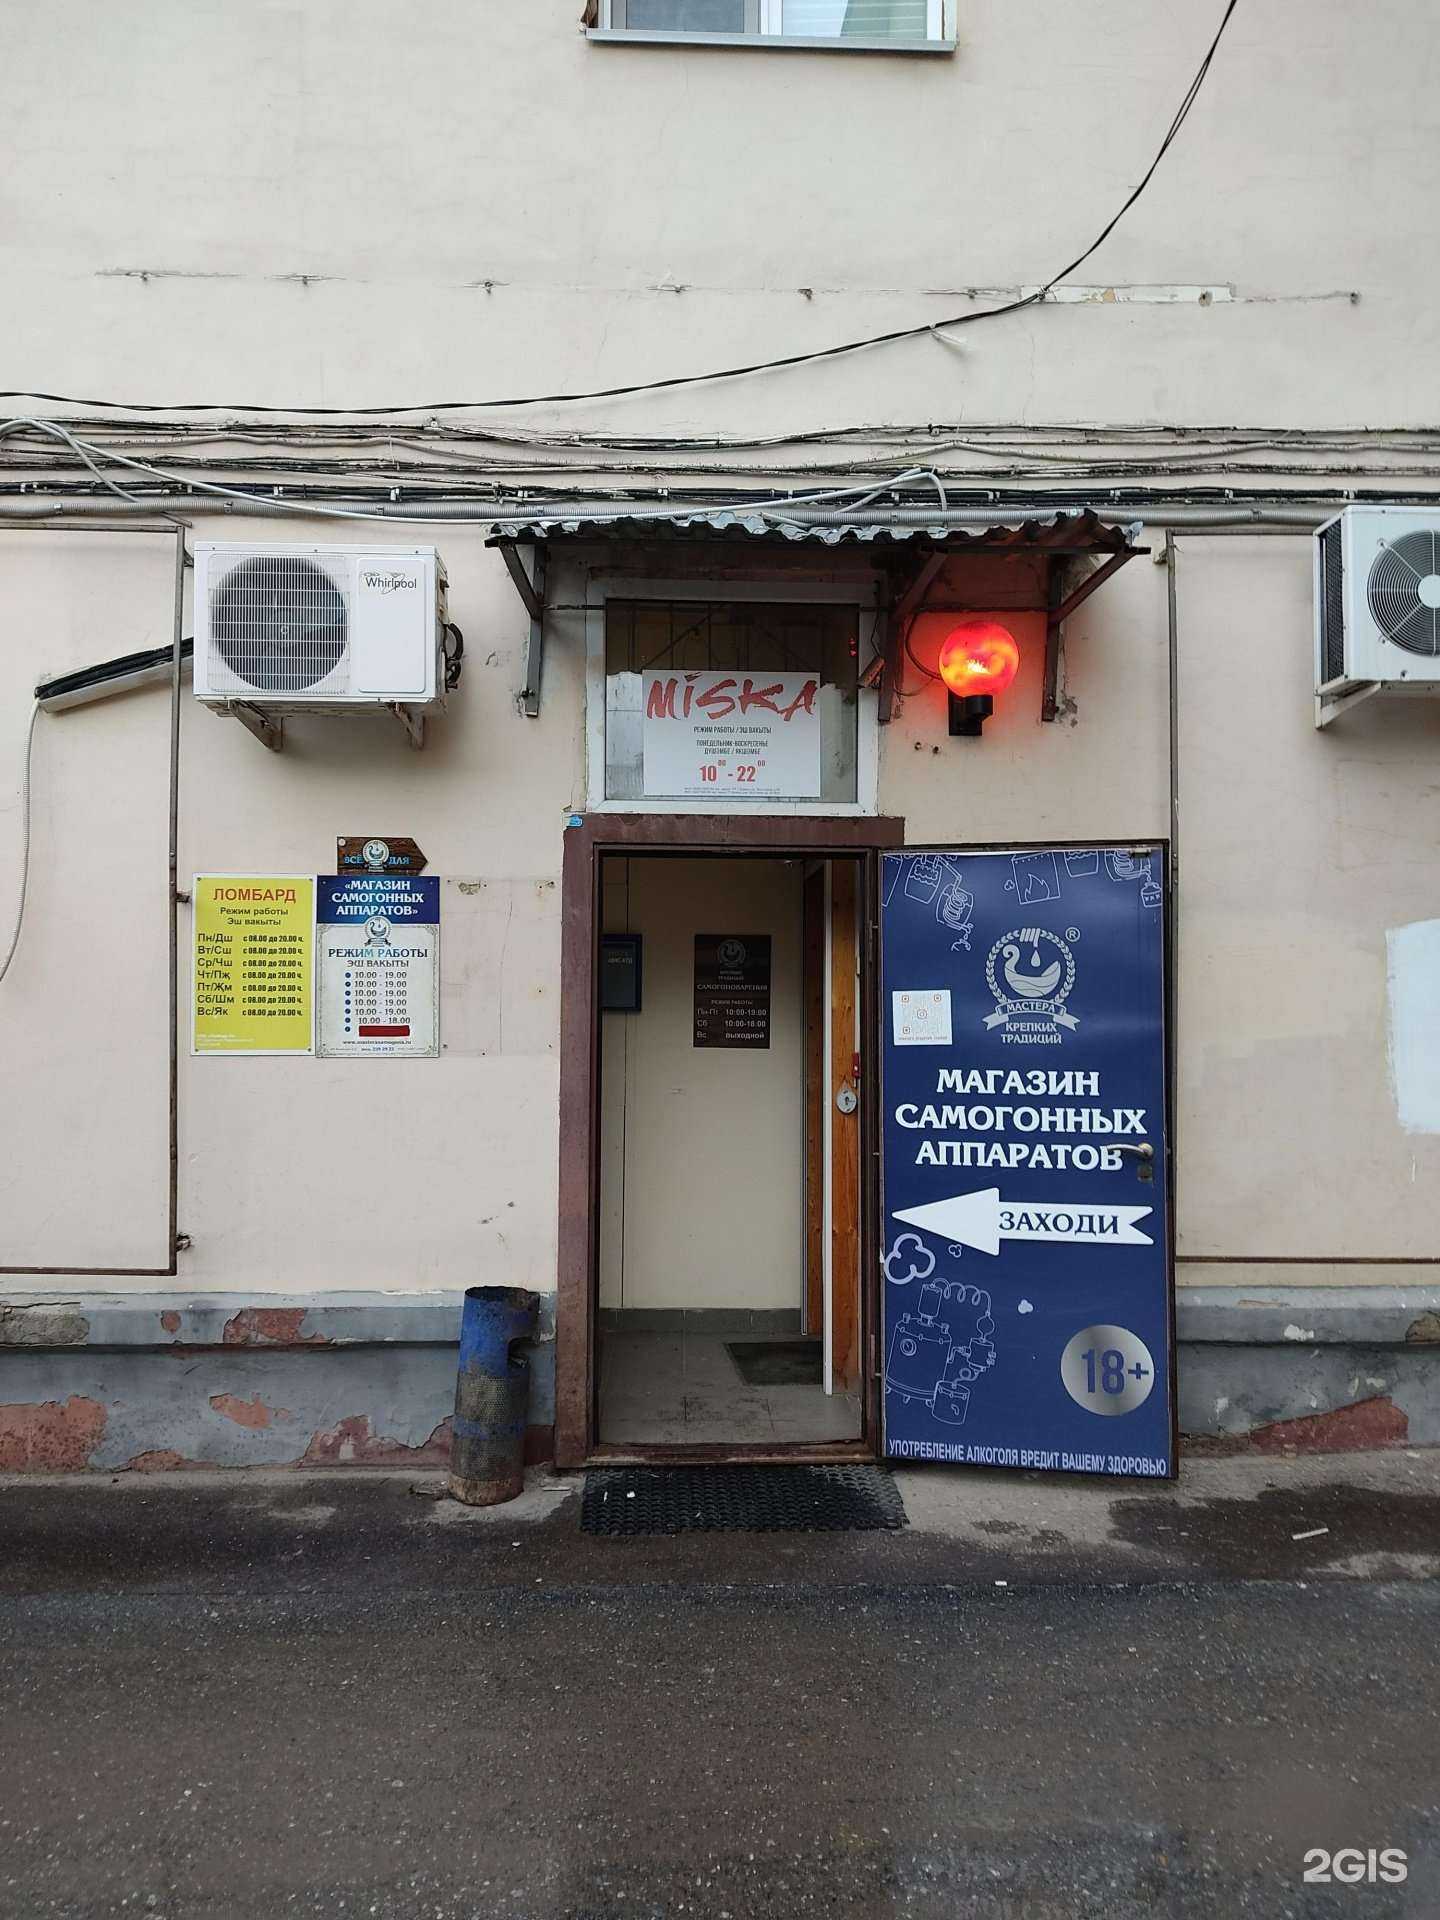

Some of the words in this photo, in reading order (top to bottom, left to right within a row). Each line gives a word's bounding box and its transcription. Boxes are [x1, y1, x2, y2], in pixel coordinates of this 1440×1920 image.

[365, 575, 417, 590] Whirlpool
[737, 766, 755, 781] 22
[345, 881, 410, 891] «МАГАЗИН
[214, 889, 296, 903] ЛОМБАРД
[331, 893, 424, 903] САМОГОННЫХ
[253, 907, 289, 916] работы
[336, 905, 418, 915] АППАРАТОВ»
[198, 934, 232, 943] Пн/Дш
[198, 946, 231, 954] Вт/Сш
[328, 949, 373, 957] РЕЖИМ
[378, 949, 427, 957] РАБОТЫ
[198, 958, 232, 968] Ср/Чш
[198, 995, 234, 1003] Сб/Шм
[198, 1007, 228, 1015] Вс/Як
[1007, 1002, 1055, 1012] МАСТЕРА
[1006, 1023, 1057, 1031] КРЕПКИХ
[1001, 1033, 1061, 1044] ТРАДИЦИЙ
[937, 1069, 1100, 1096] МАГАЗИН
[895, 1104, 1147, 1134] САМОГОННЫХ
[915, 1141, 1123, 1170] АППАРАТОВ
[999, 1210, 1119, 1235] ЗАХОДИ
[1081, 1349, 1149, 1395] 18+
[889, 1439, 964, 1461] УПОТРЕБЛЕНИЕ
[967, 1447, 1018, 1464] АЛКОГОЛЯ
[1021, 1451, 1059, 1469] ВРЕДИТ
[1062, 1454, 1106, 1471] ВАШЕМУ
[1108, 1456, 1166, 1475] ЗДОРОВЬЮ
